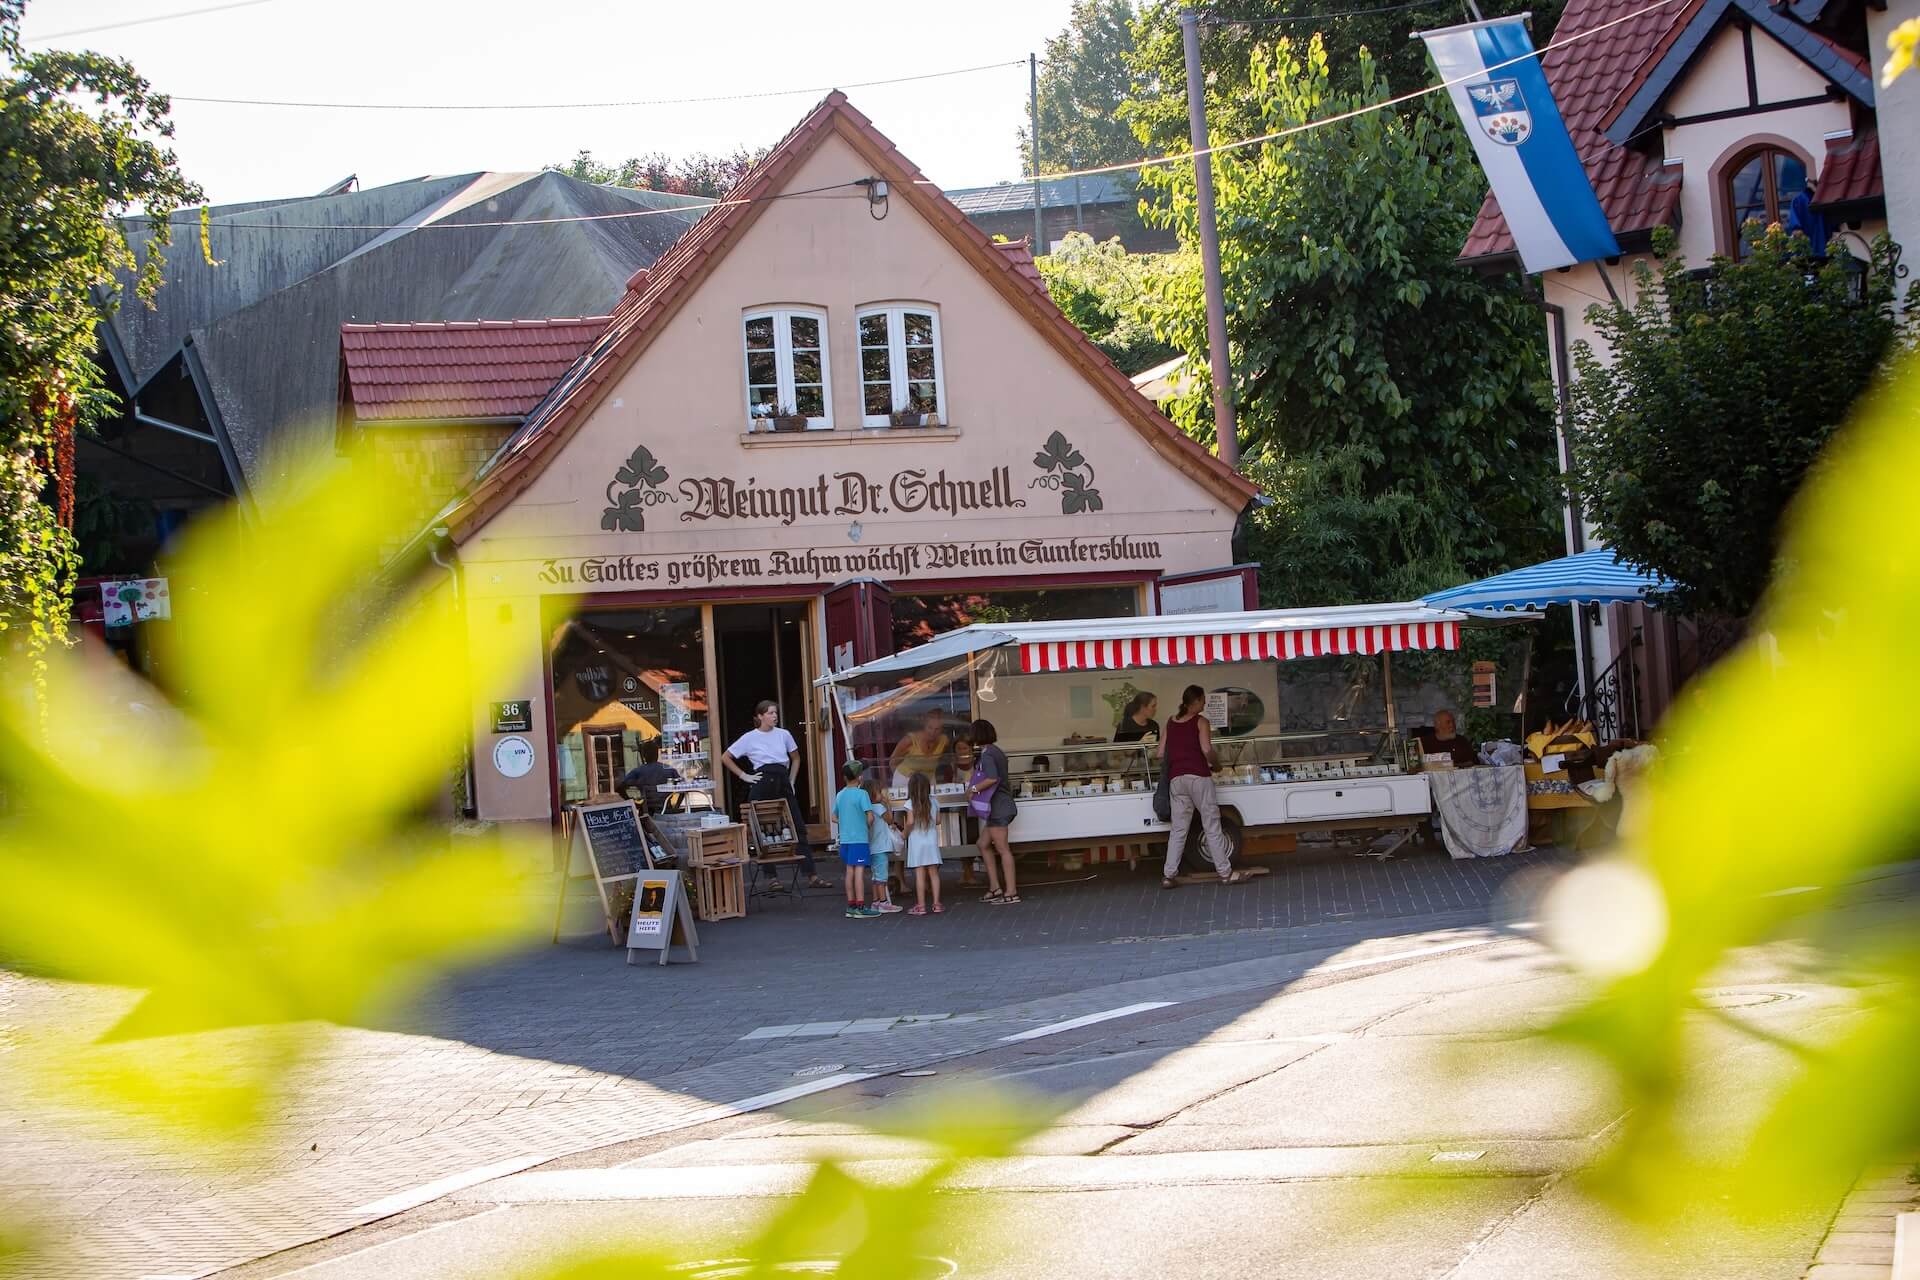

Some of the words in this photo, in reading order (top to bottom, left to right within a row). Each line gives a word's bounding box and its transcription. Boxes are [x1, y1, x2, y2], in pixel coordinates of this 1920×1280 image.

[678, 474, 830, 526] Weingut
[833, 471, 889, 515] Dr.
[889, 465, 1026, 517] Schnell
[538, 560, 576, 585] Zu
[580, 554, 660, 583] Gottes
[767, 548, 843, 580] Ruhm
[844, 543, 921, 576] wächst
[925, 543, 994, 570] Wein
[995, 541, 1017, 566] in
[1018, 535, 1163, 565] Guntersblum
[502, 703, 520, 717] 36
